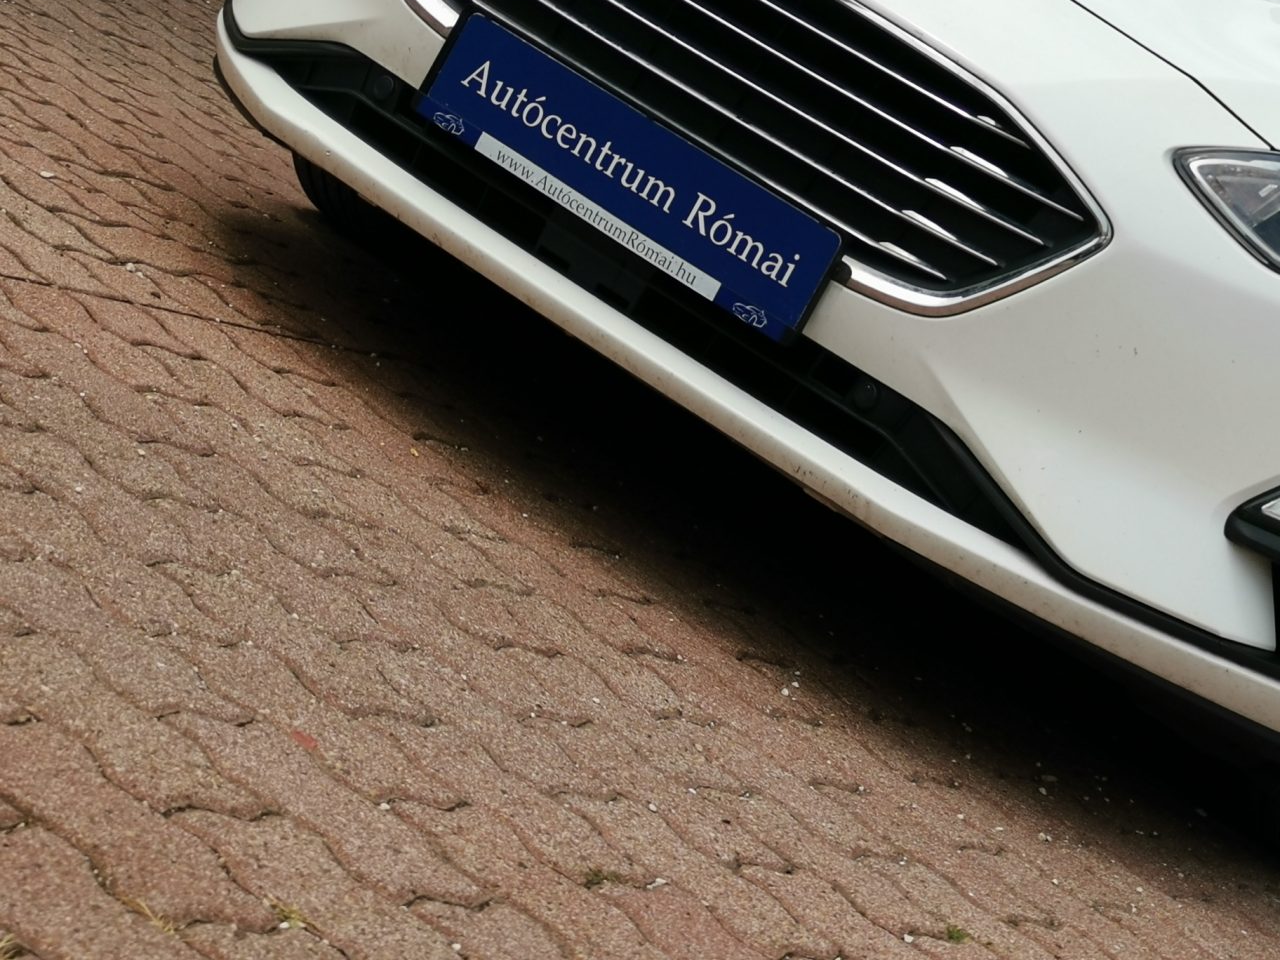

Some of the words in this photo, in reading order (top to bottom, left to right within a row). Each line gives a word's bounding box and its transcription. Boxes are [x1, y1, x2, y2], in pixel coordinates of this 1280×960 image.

[460, 59, 677, 215] Autócentrum
[682, 191, 801, 289] Római
[496, 150, 697, 286] www.AutócentrumRómai.hu
